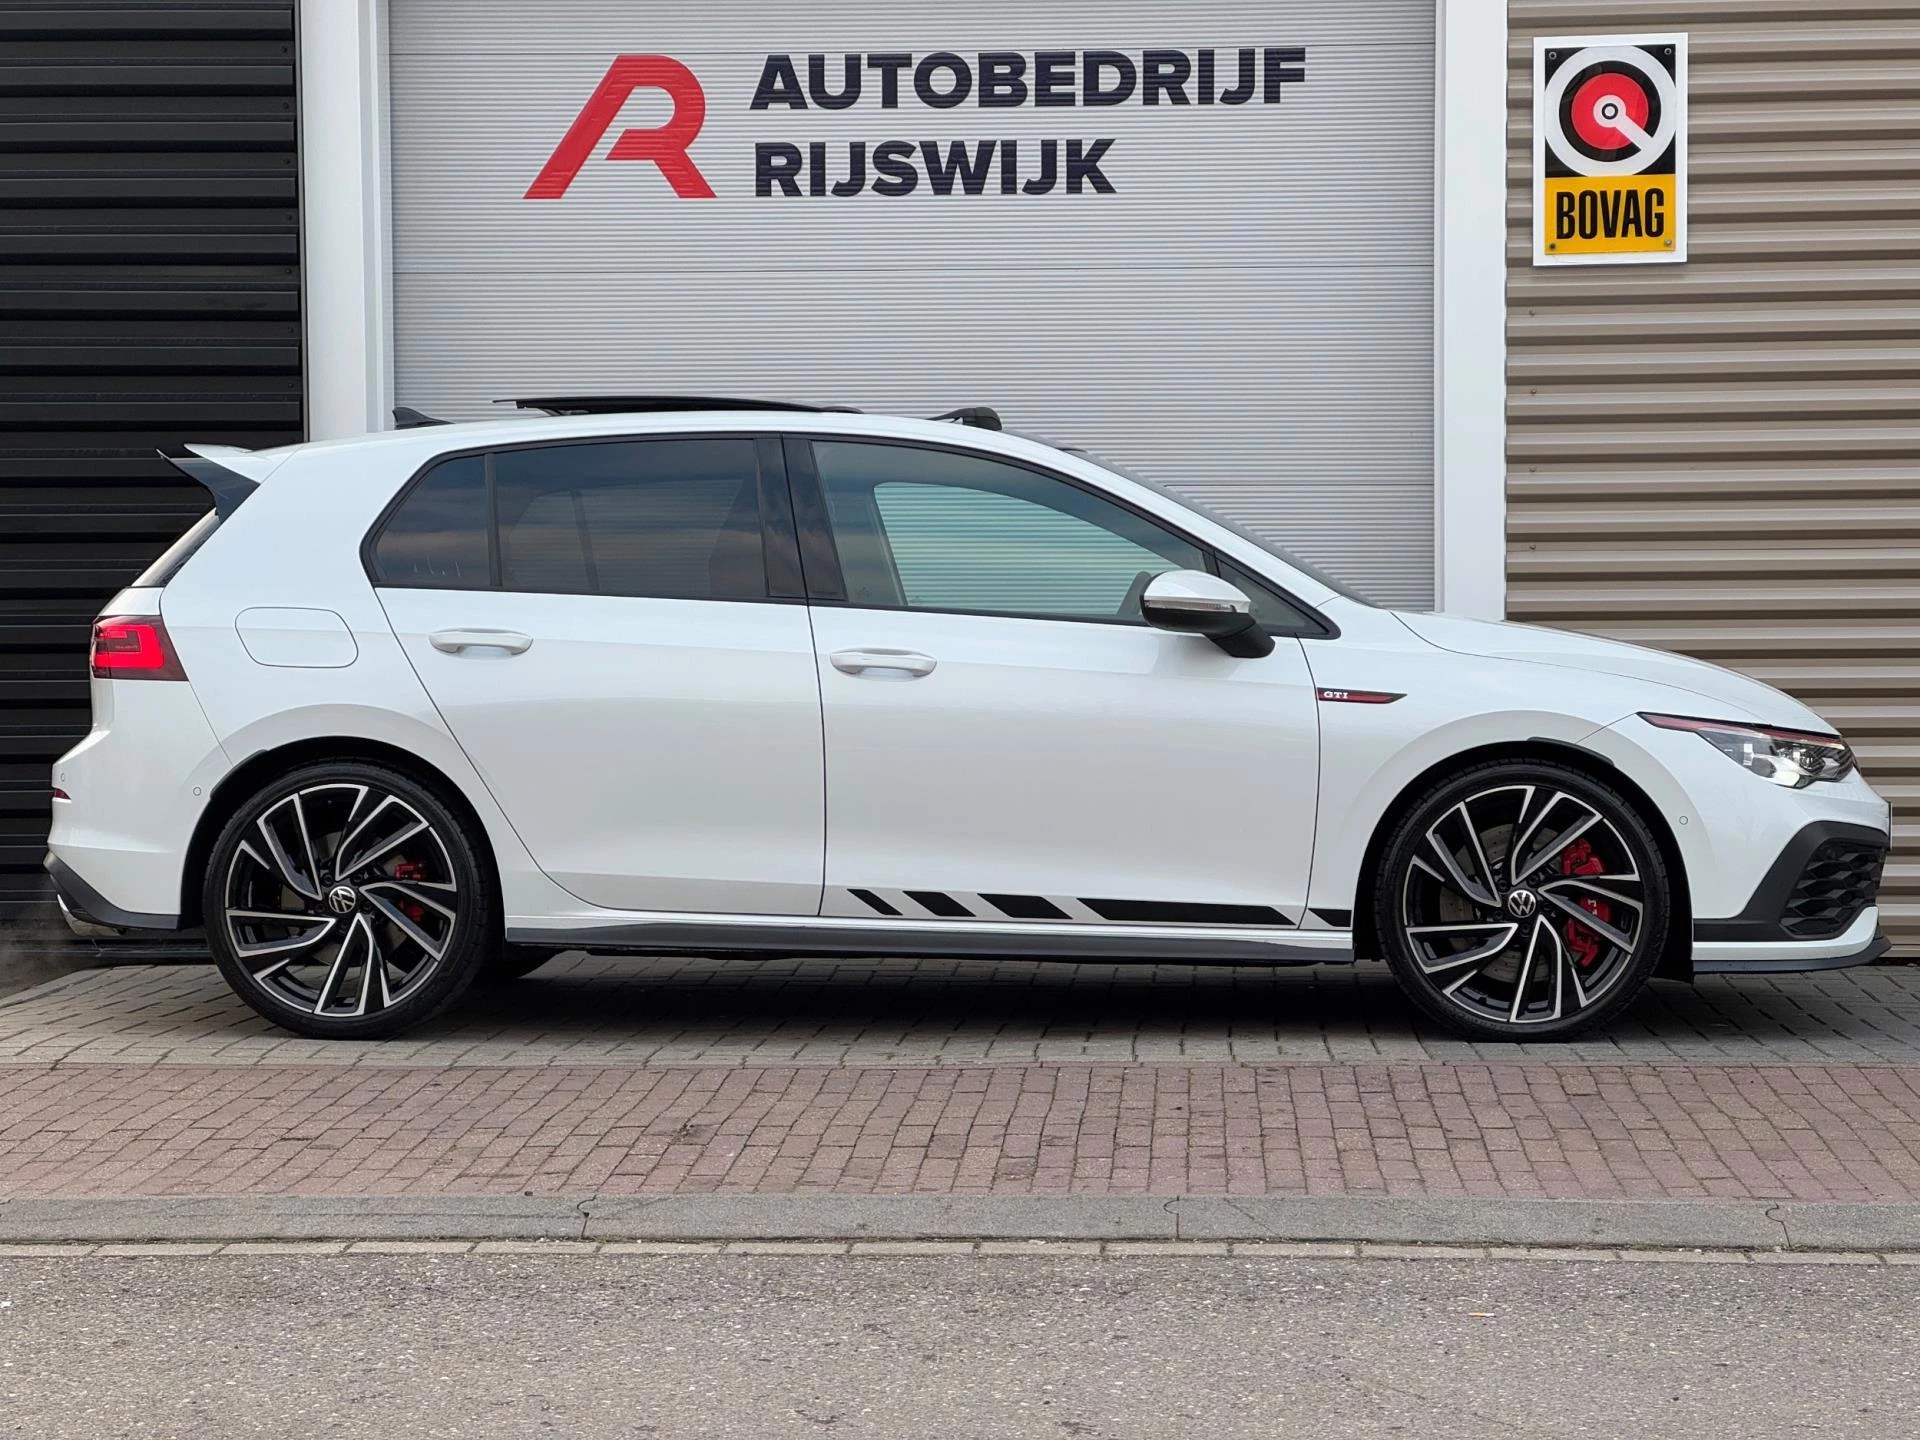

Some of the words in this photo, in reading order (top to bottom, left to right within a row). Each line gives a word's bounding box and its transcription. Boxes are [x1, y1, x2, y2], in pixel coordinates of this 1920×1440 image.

[749, 47, 1306, 111] AUTOBEDRIJF
[754, 138, 1117, 198] RIJSWIJK
[1556, 187, 1665, 240] BOVAG
[1323, 690, 1349, 699] GTI
